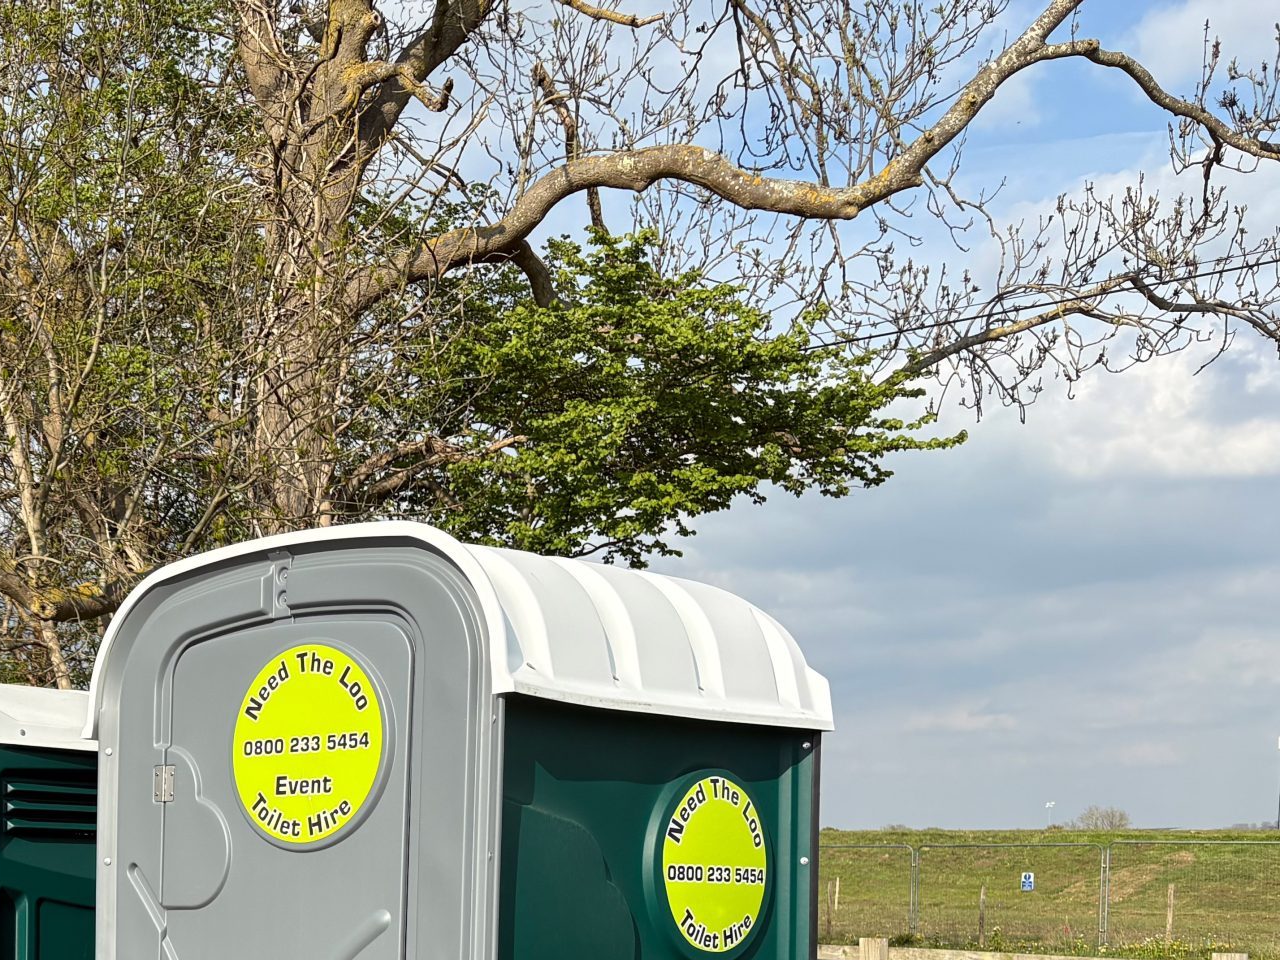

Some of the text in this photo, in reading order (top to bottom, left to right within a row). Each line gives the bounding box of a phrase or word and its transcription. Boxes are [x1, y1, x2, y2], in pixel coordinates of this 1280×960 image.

[245, 652, 368, 720] Need The Loo
[244, 732, 369, 756] 0800 233 5454
[276, 775, 332, 795] Event
[252, 792, 351, 836] Toilet Hire
[668, 779, 762, 848] Need The Loo
[668, 865, 764, 884] 0800 233 5454
[680, 909, 752, 949] Toilet Hire
